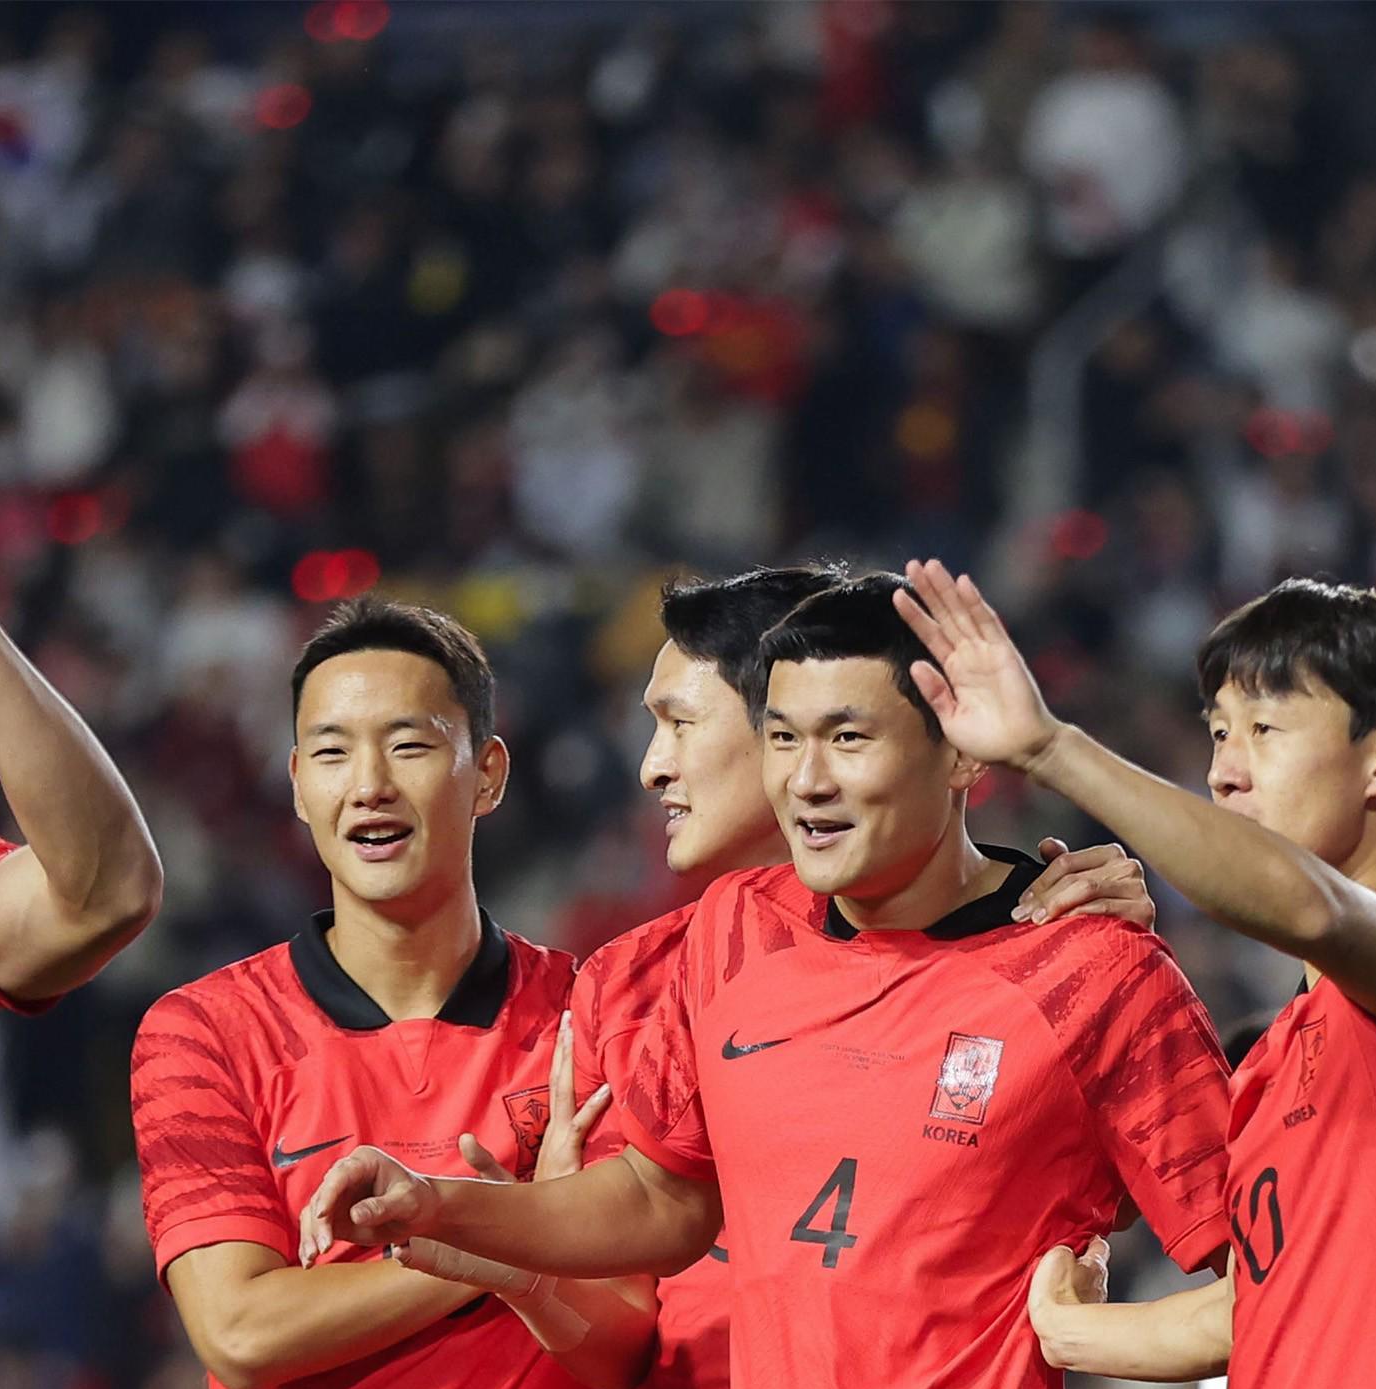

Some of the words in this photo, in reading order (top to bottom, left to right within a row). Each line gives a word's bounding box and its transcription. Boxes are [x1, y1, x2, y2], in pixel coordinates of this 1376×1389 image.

[1282, 1103, 1317, 1131] KOREA
[922, 1124, 979, 1148] KOREA
[790, 1157, 858, 1269] 4
